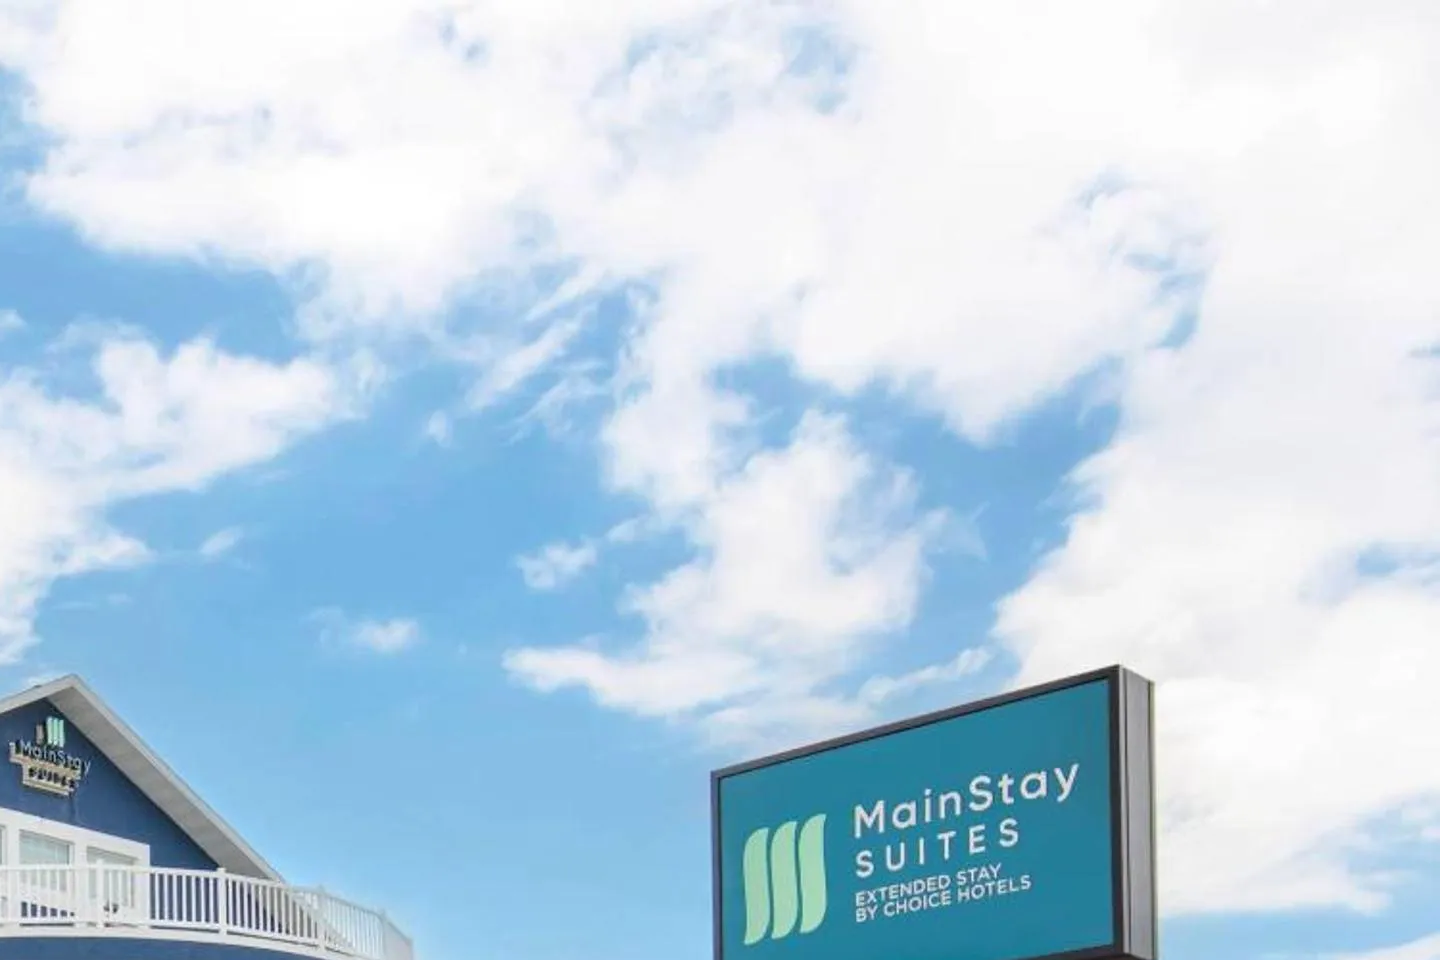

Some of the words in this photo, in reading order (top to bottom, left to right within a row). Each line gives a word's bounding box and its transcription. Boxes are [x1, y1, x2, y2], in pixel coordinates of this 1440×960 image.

[854, 763, 1079, 838] MainStay
[855, 818, 1019, 878] SUITES
[855, 874, 951, 907] EXTENDED
[956, 862, 1002, 886] STAY
[855, 905, 878, 923] BY
[883, 890, 952, 917] CHOICE
[957, 874, 1032, 903] HOTELS
